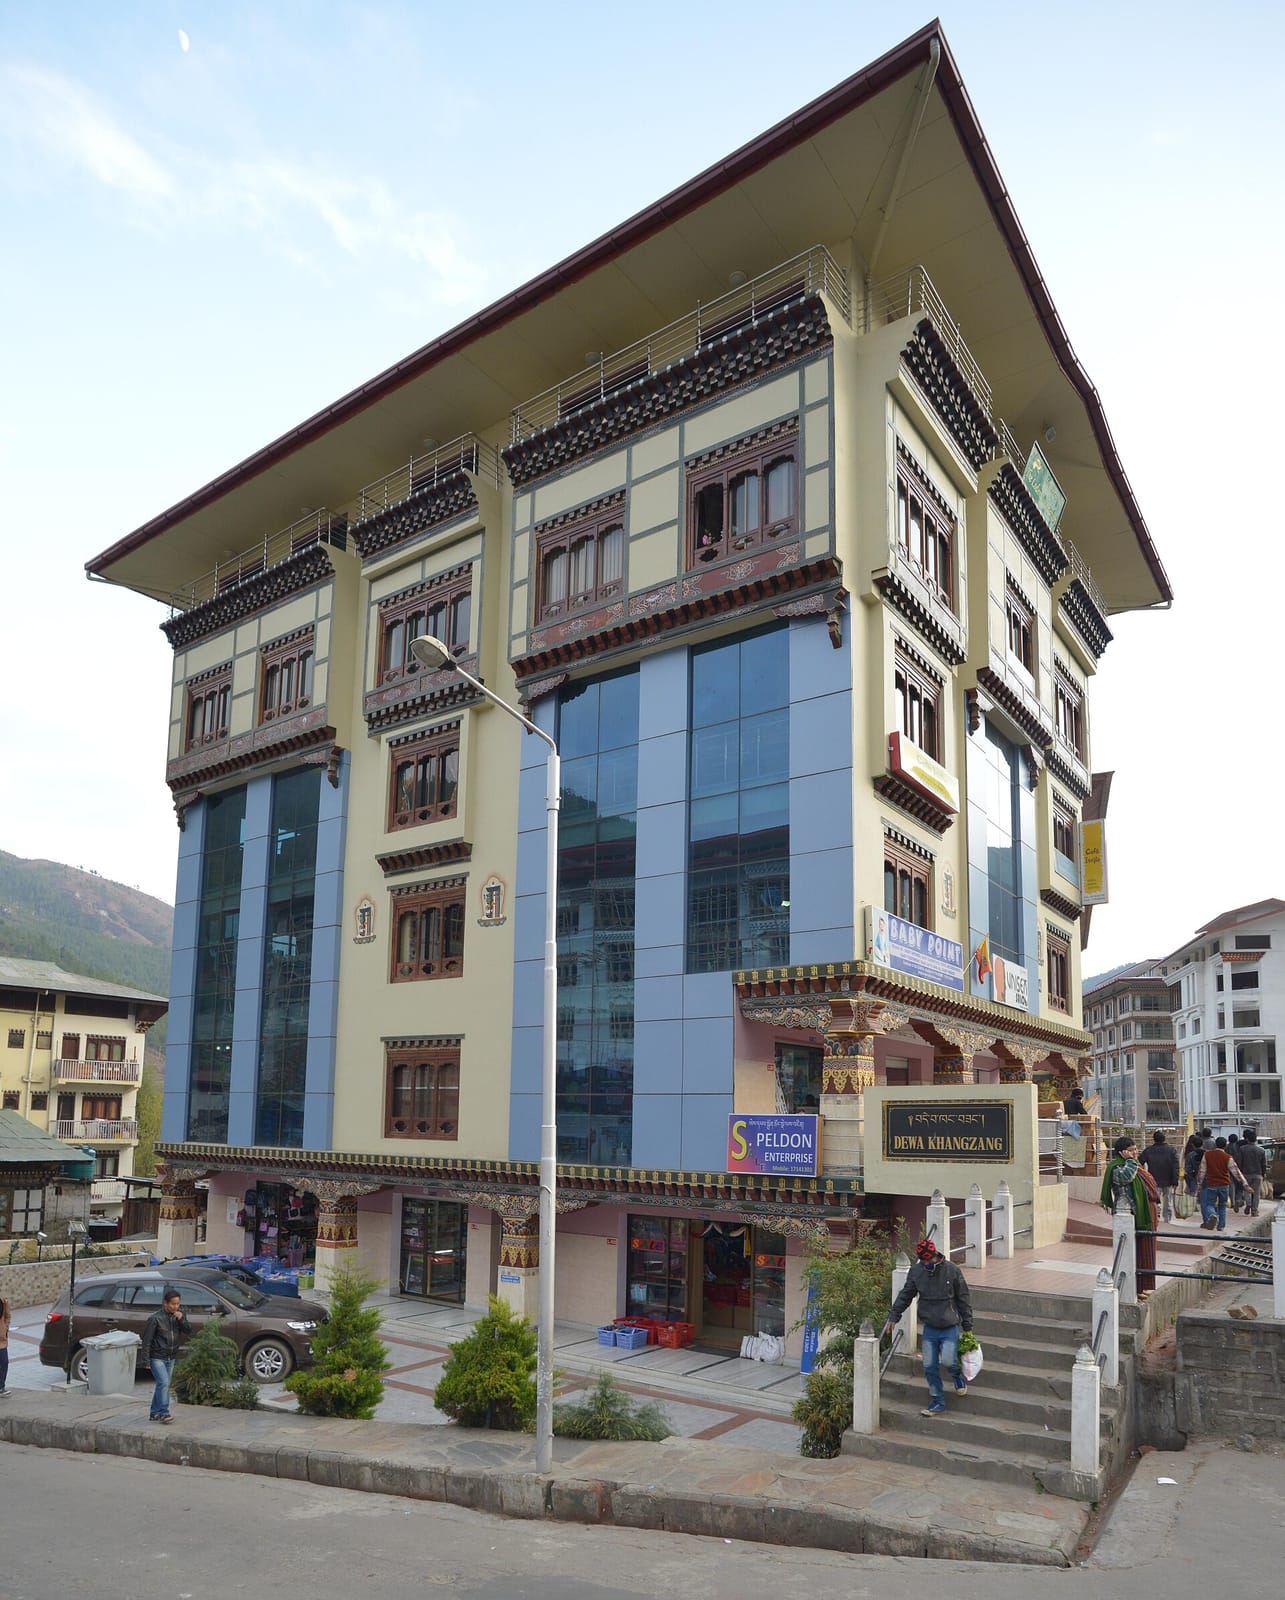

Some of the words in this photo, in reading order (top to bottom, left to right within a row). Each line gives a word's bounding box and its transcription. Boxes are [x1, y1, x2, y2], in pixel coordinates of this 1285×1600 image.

[890, 919, 923, 950] BABY
[927, 934, 961, 966] POINT
[756, 1132, 812, 1149] PELDON
[893, 1135, 924, 1150] DEWA
[928, 1135, 1003, 1151] KHANGZANG
[764, 1152, 814, 1164] ENTERPRISE
